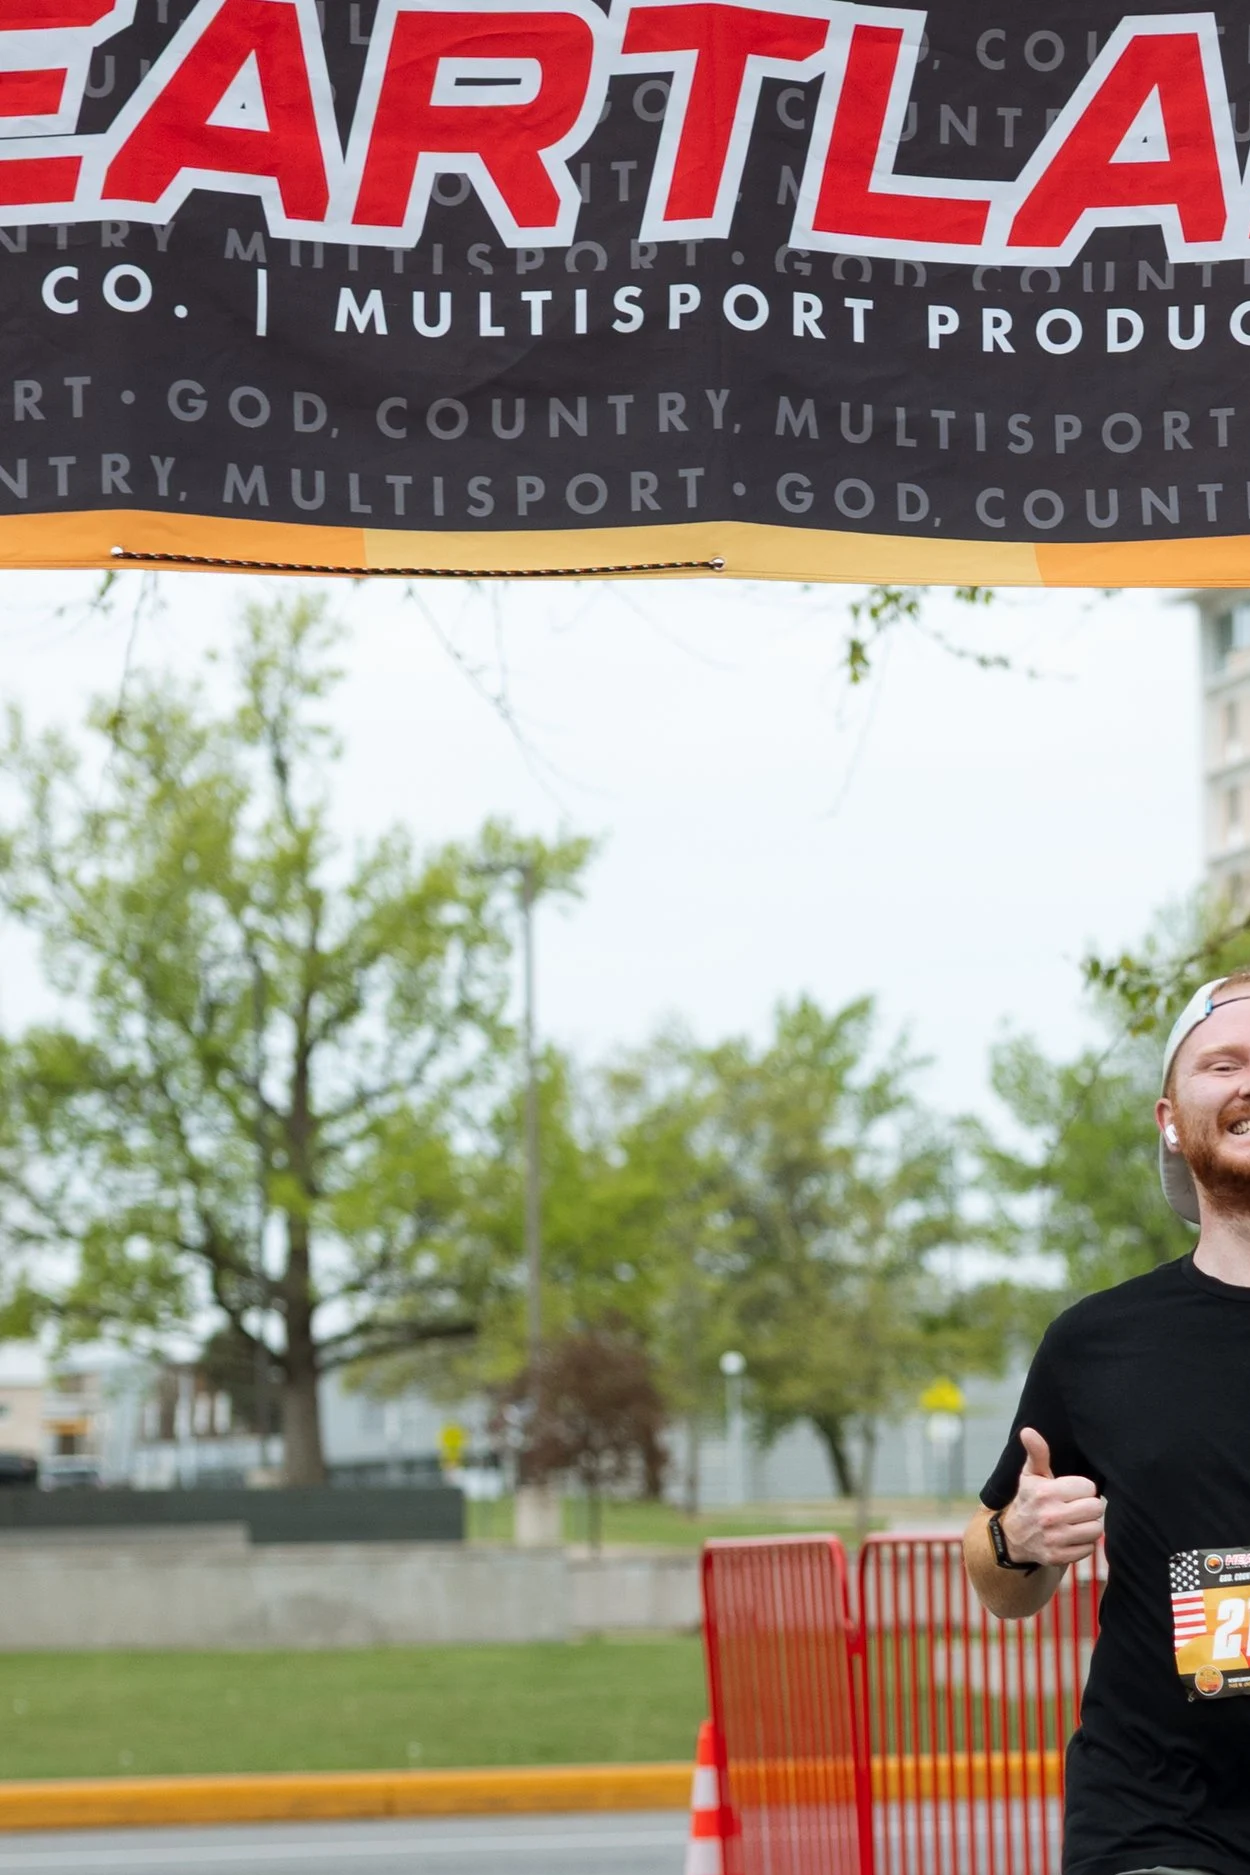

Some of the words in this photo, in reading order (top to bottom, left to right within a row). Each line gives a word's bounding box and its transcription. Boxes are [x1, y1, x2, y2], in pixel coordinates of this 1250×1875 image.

[40, 263, 189, 319] CO.
[334, 283, 875, 344] MULTISPORT
[167, 379, 339, 438] GOD,
[376, 388, 742, 441] COUNTRY,
[775, 395, 1236, 455] MULTISPORT
[222, 463, 705, 518] MULTISPORT
[776, 472, 942, 528] GOD,
